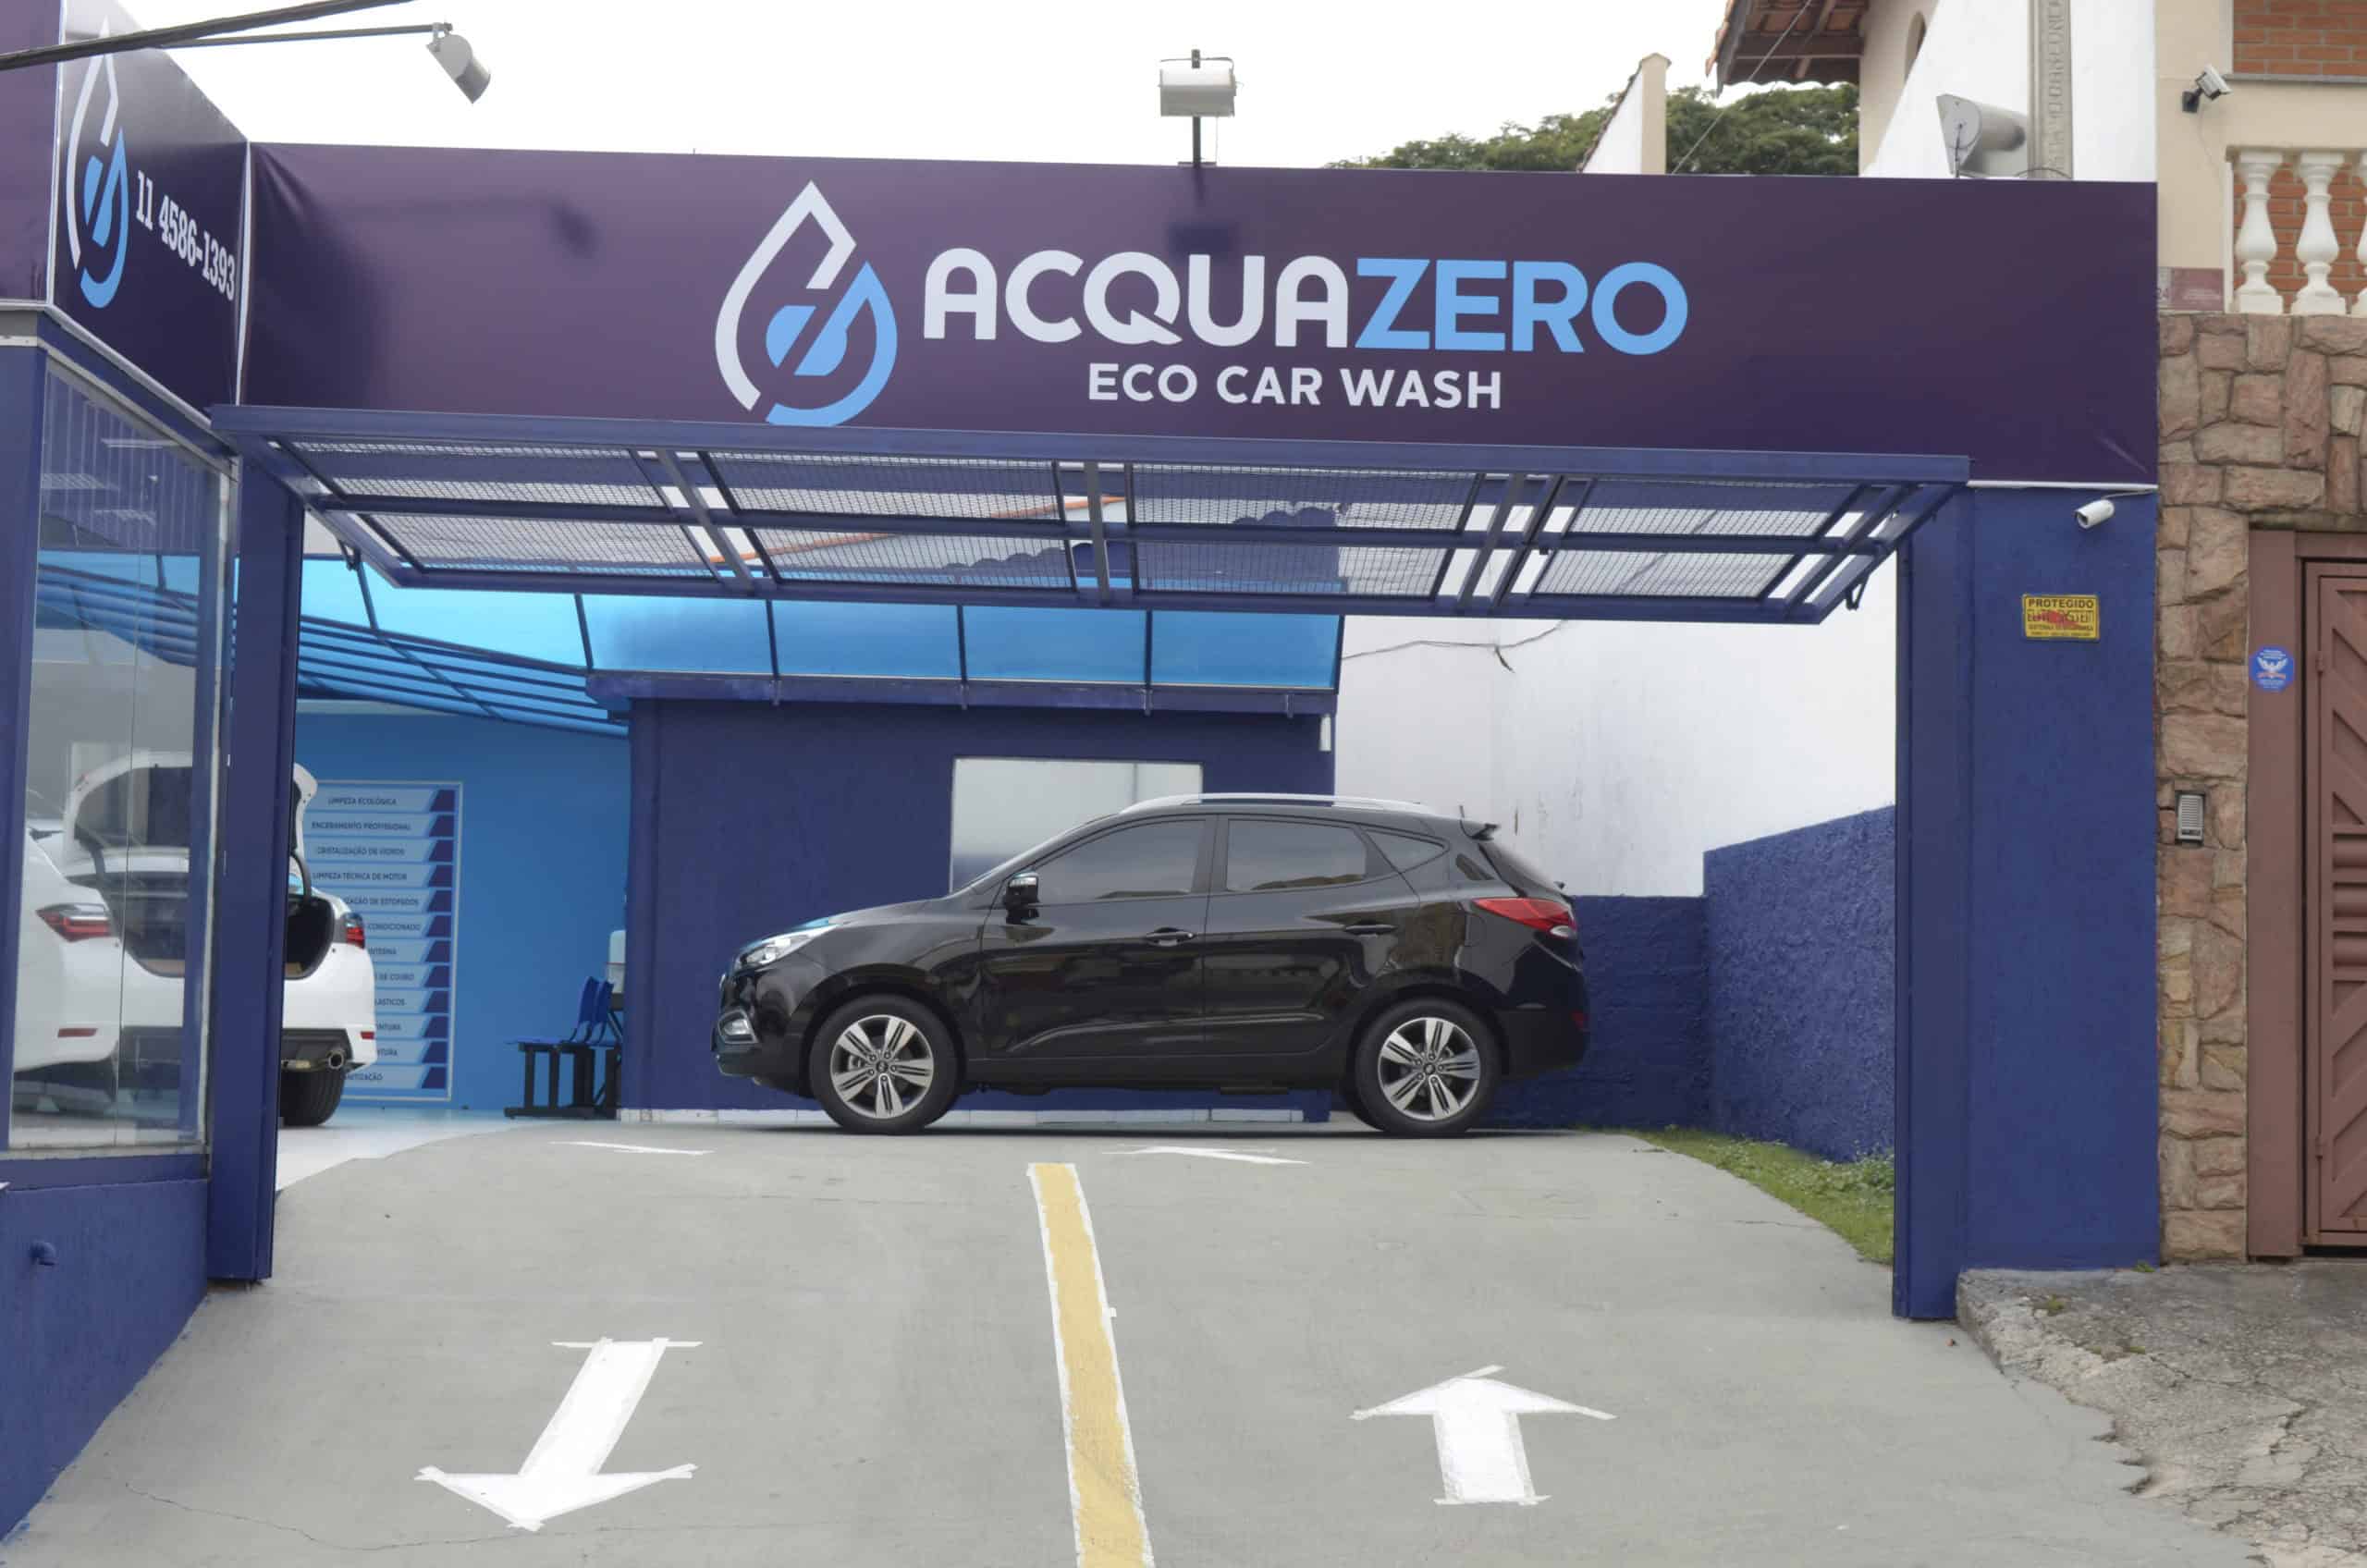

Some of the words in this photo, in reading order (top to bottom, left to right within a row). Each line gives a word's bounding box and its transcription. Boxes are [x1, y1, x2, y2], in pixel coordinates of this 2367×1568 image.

[136, 169, 153, 231] 11
[159, 194, 236, 300] 4586-1393
[924, 247, 1688, 356] ACQUAZERO
[1088, 361, 1198, 404] ECO
[1216, 364, 1323, 406] CAR
[1340, 369, 1502, 410] WASH
[2028, 598, 2094, 608] PROTEGIDO
[327, 797, 356, 805] LIMPEZA
[313, 872, 341, 881] LIMPEZA
[372, 873, 381, 881] DE
[383, 873, 408, 881] MOTOR
